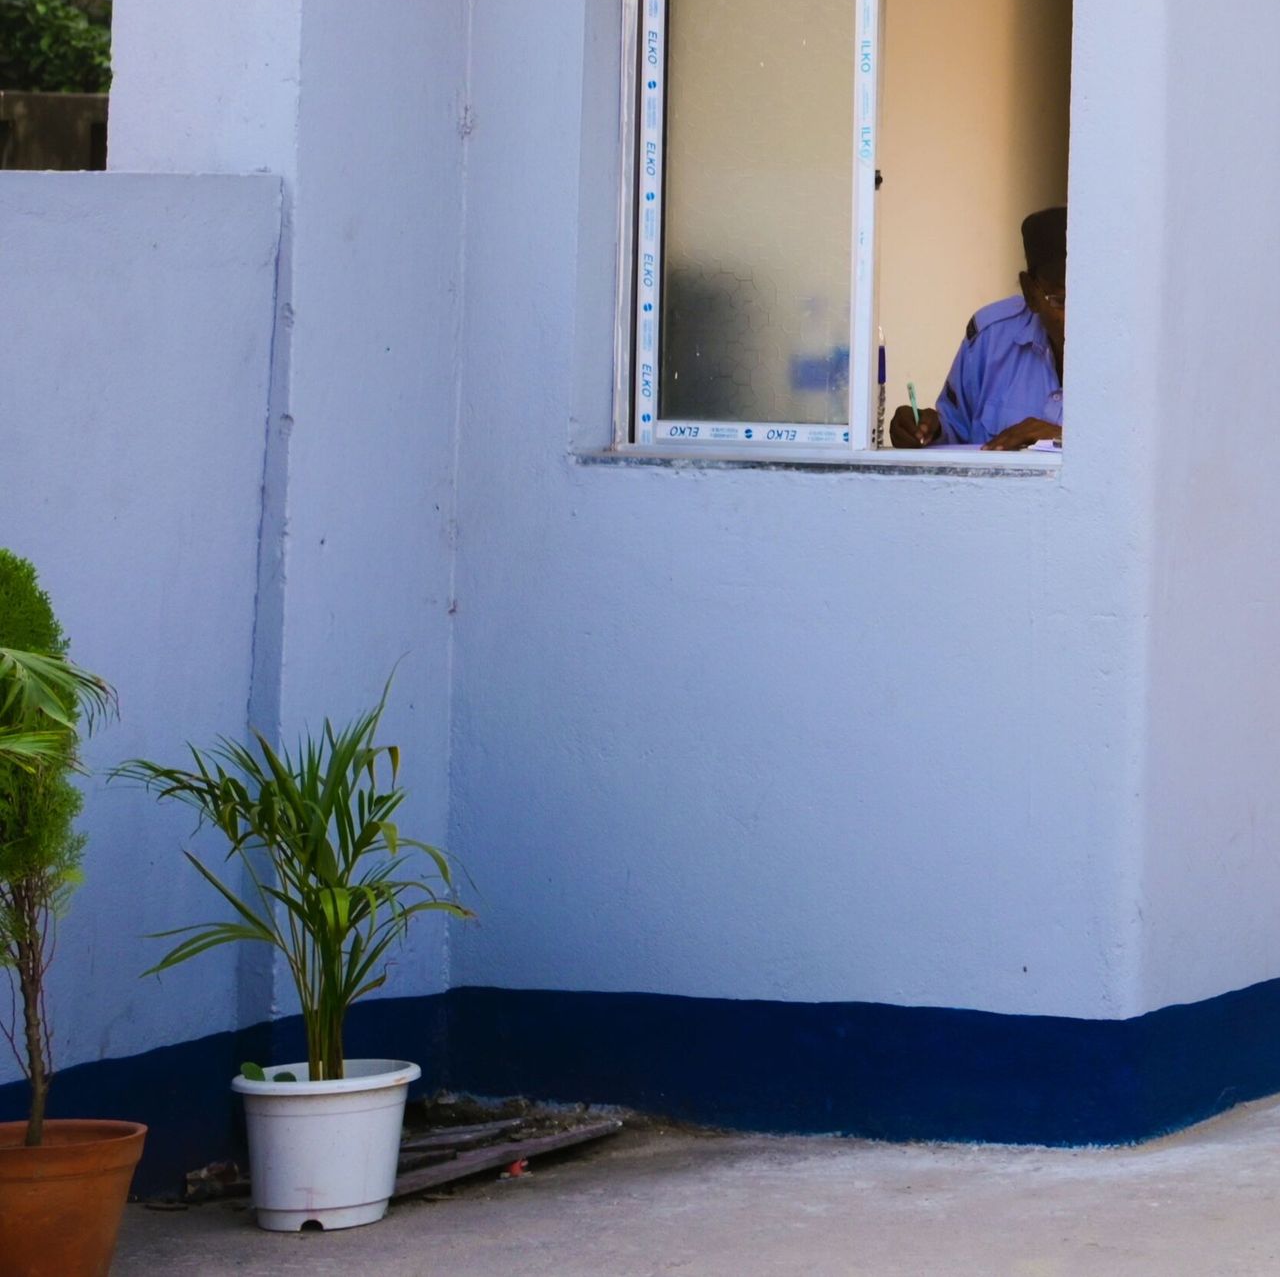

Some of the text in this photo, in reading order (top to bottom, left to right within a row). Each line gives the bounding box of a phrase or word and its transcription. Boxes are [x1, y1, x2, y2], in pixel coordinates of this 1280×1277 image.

[647, 30, 658, 65] ELKO
[860, 40, 871, 73] ILKO
[646, 141, 656, 176] ELKO
[643, 253, 654, 287] ELKO
[641, 363, 652, 398] ELKO
[669, 426, 700, 438] ELKO
[766, 429, 797, 441] ELKO
